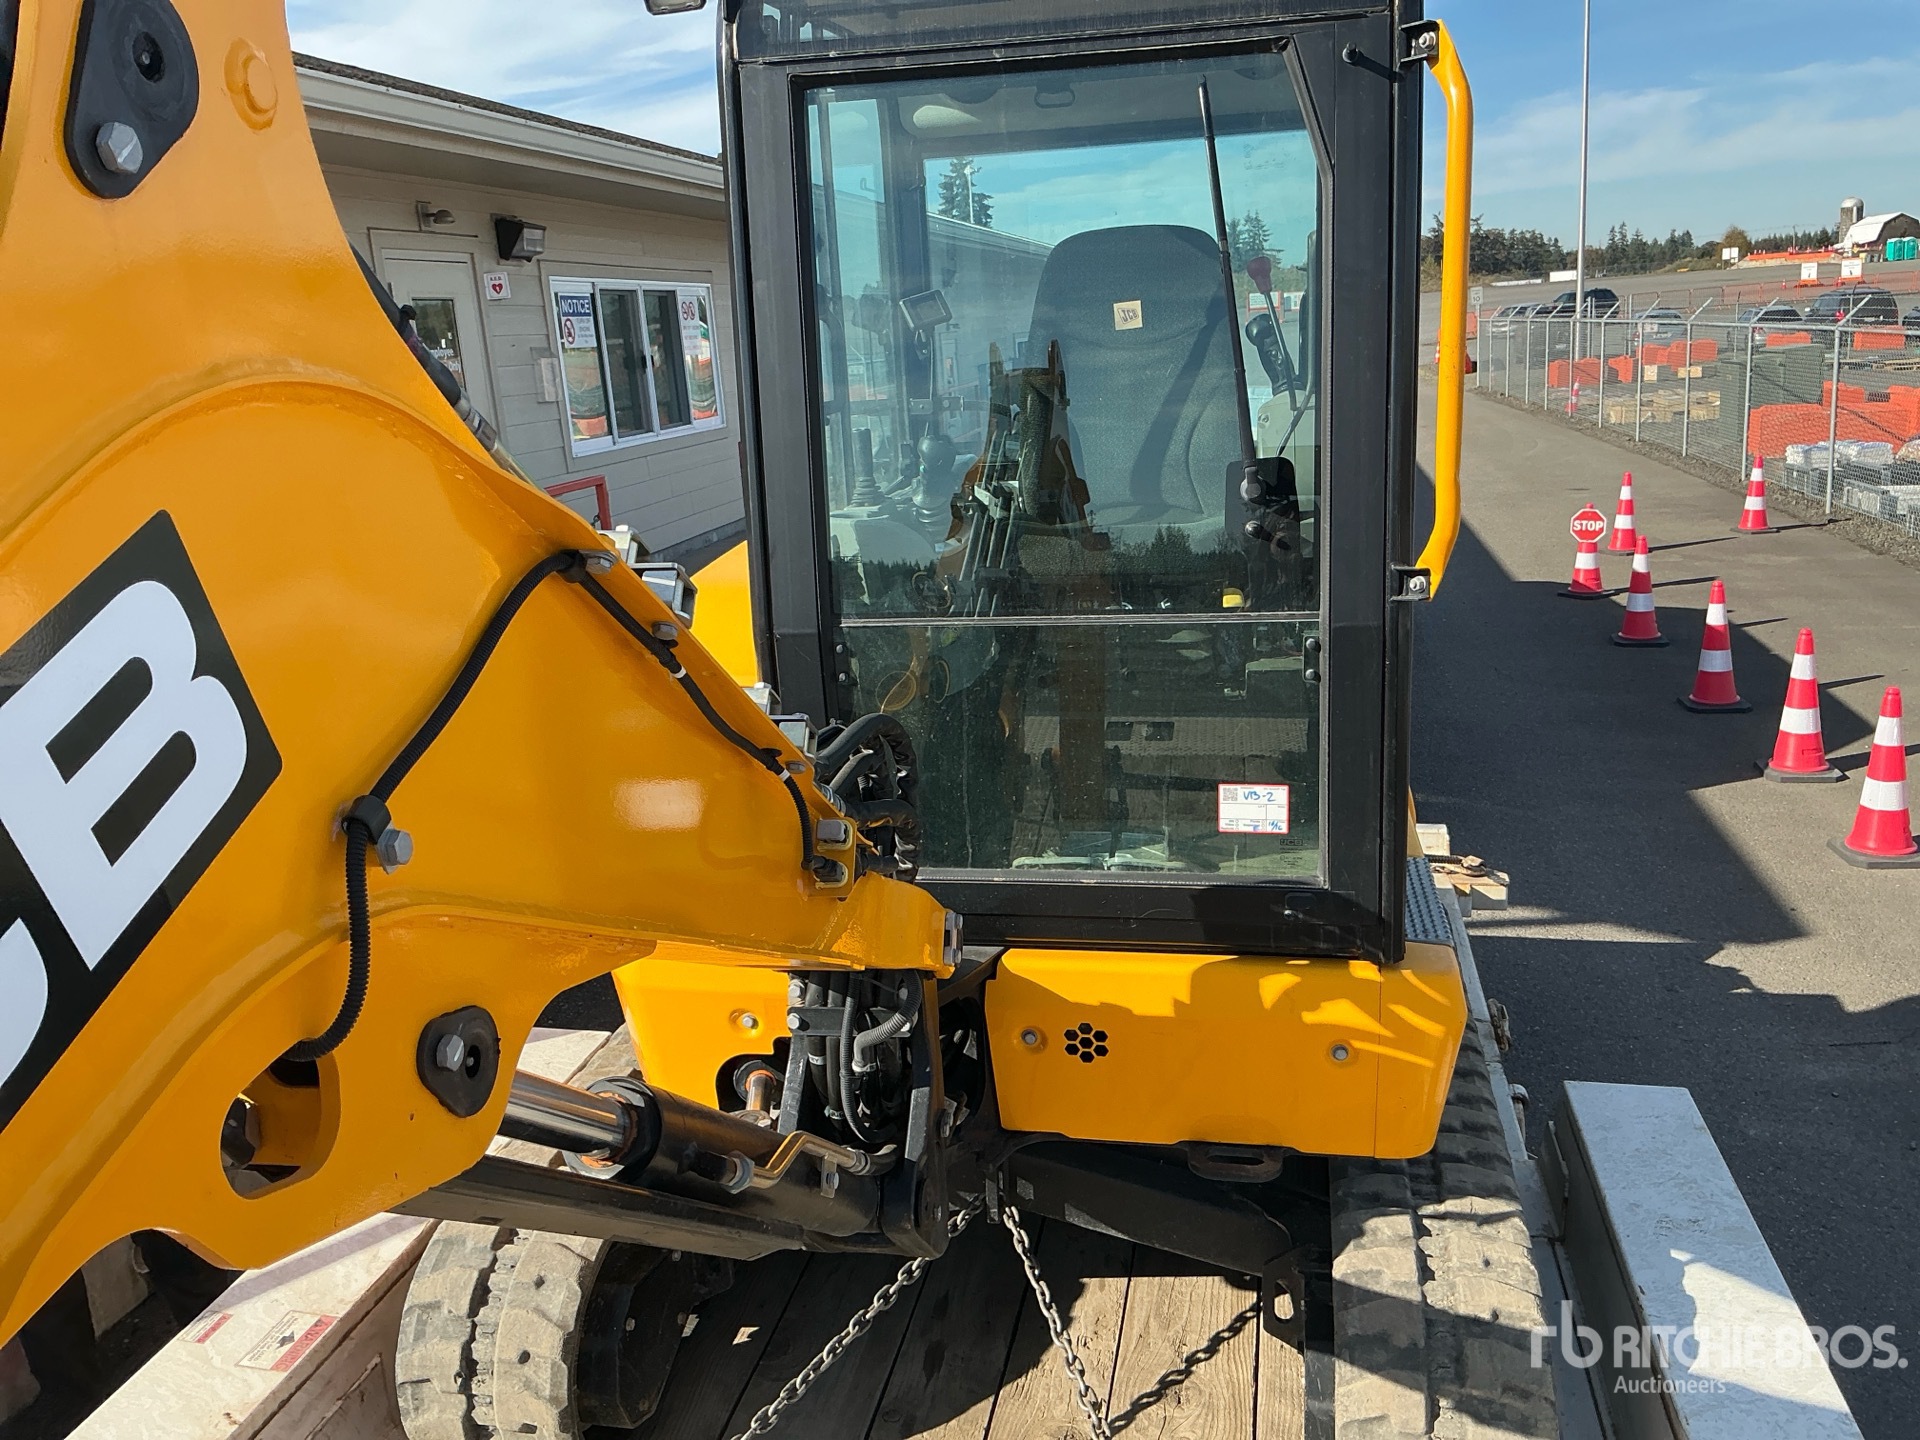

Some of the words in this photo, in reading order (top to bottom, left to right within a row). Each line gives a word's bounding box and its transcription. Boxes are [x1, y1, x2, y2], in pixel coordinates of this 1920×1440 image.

[561, 299, 591, 314] NOTICE
[1120, 309, 1139, 323] JCB
[1572, 520, 1604, 532] STOP
